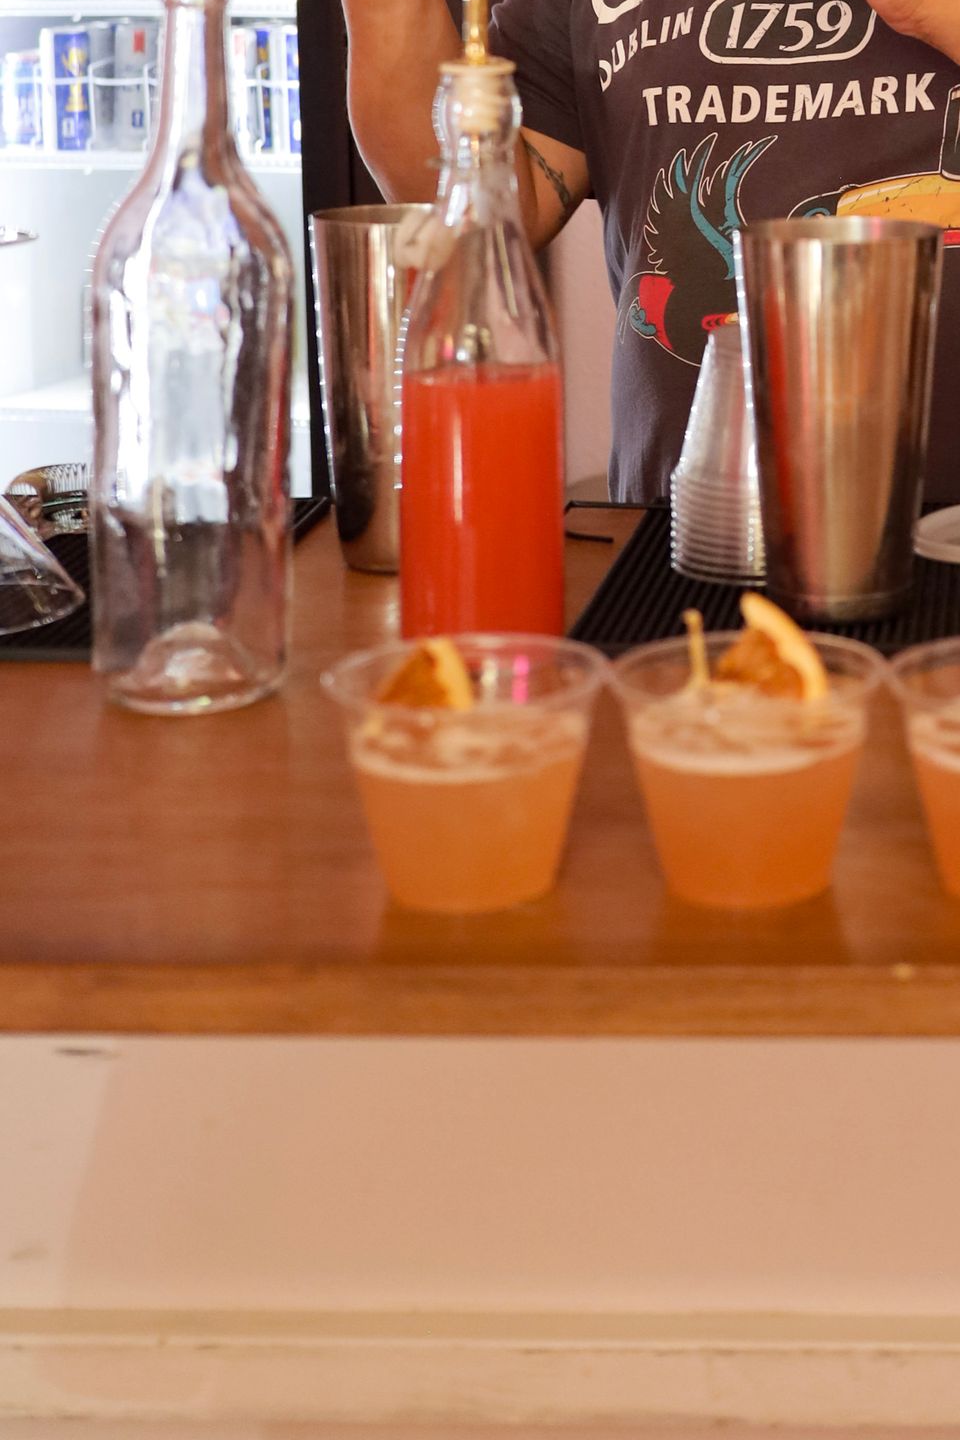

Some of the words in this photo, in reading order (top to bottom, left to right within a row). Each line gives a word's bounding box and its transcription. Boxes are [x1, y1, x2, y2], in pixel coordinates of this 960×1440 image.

[598, 6, 695, 93] DUBLIN
[724, 0, 853, 53] 1759
[642, 72, 936, 126] TRADEMARK
